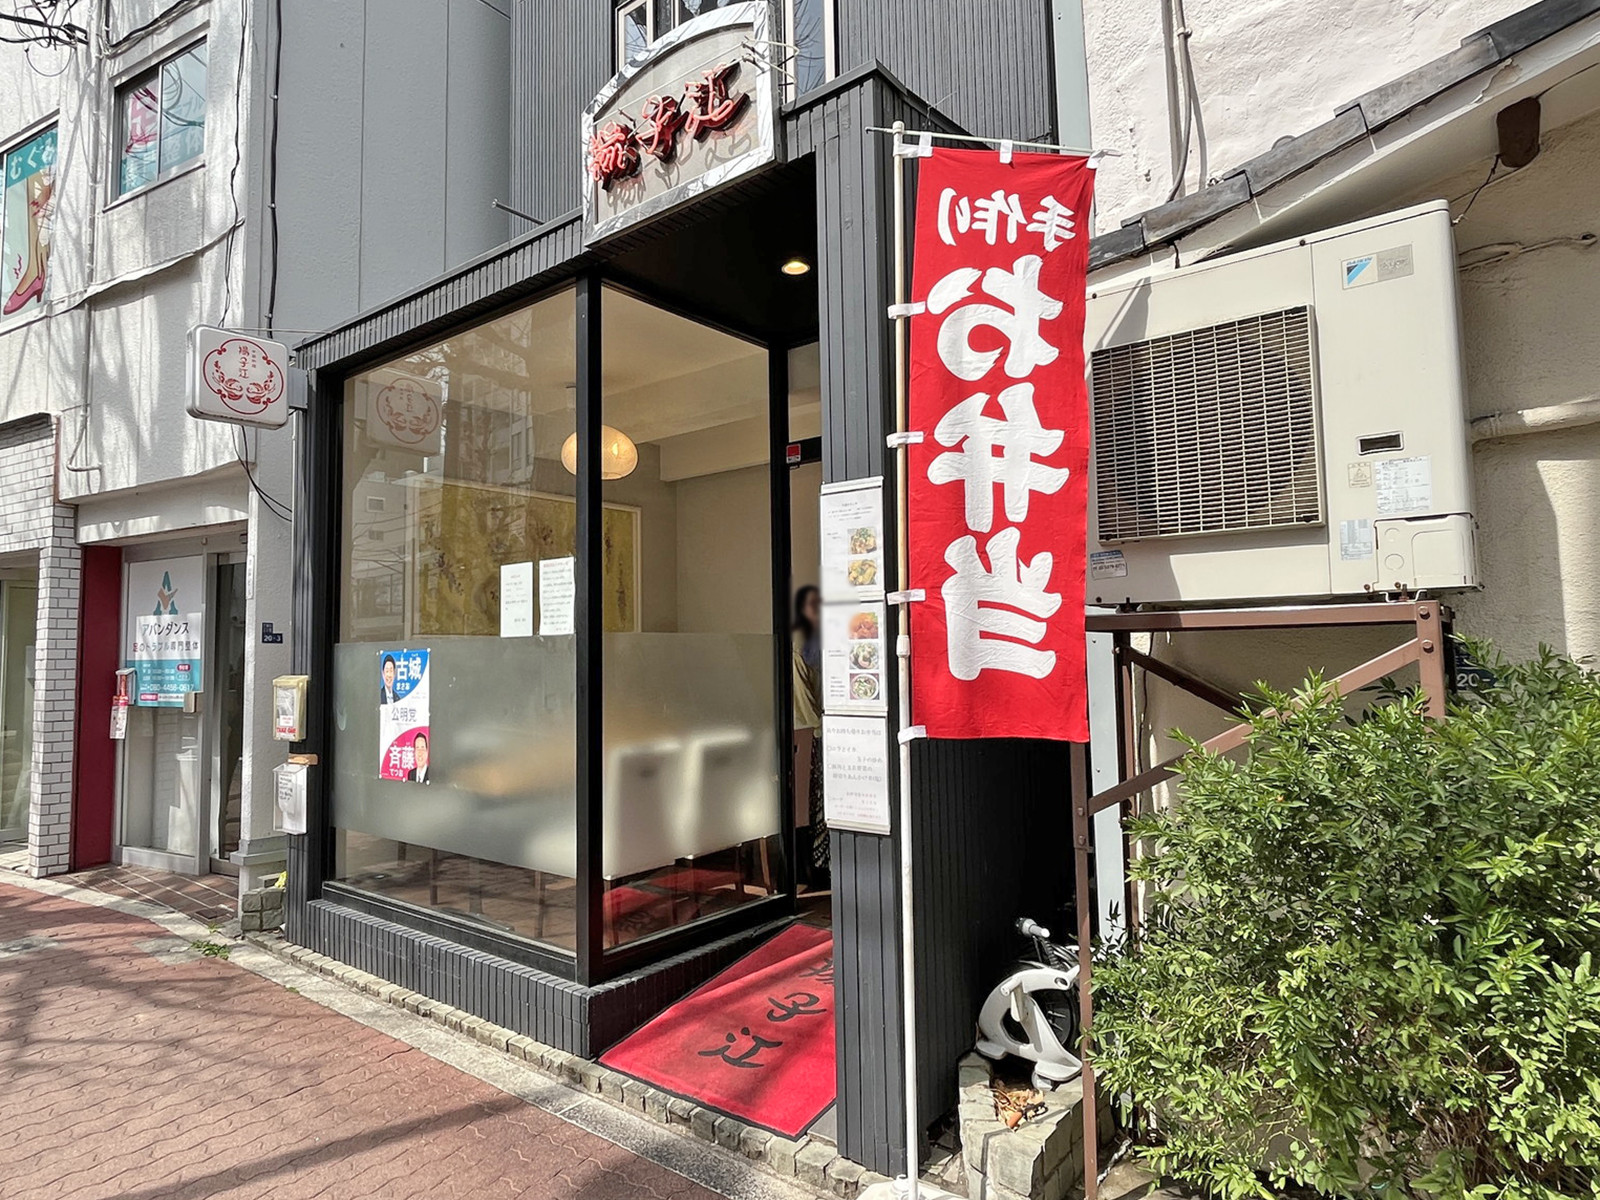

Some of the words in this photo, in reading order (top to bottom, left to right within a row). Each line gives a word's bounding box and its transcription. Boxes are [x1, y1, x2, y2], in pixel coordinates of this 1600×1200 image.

[395, 656, 422, 681] 古城
[391, 707, 417, 723] 公明党
[388, 745, 415, 769] 斉藤
